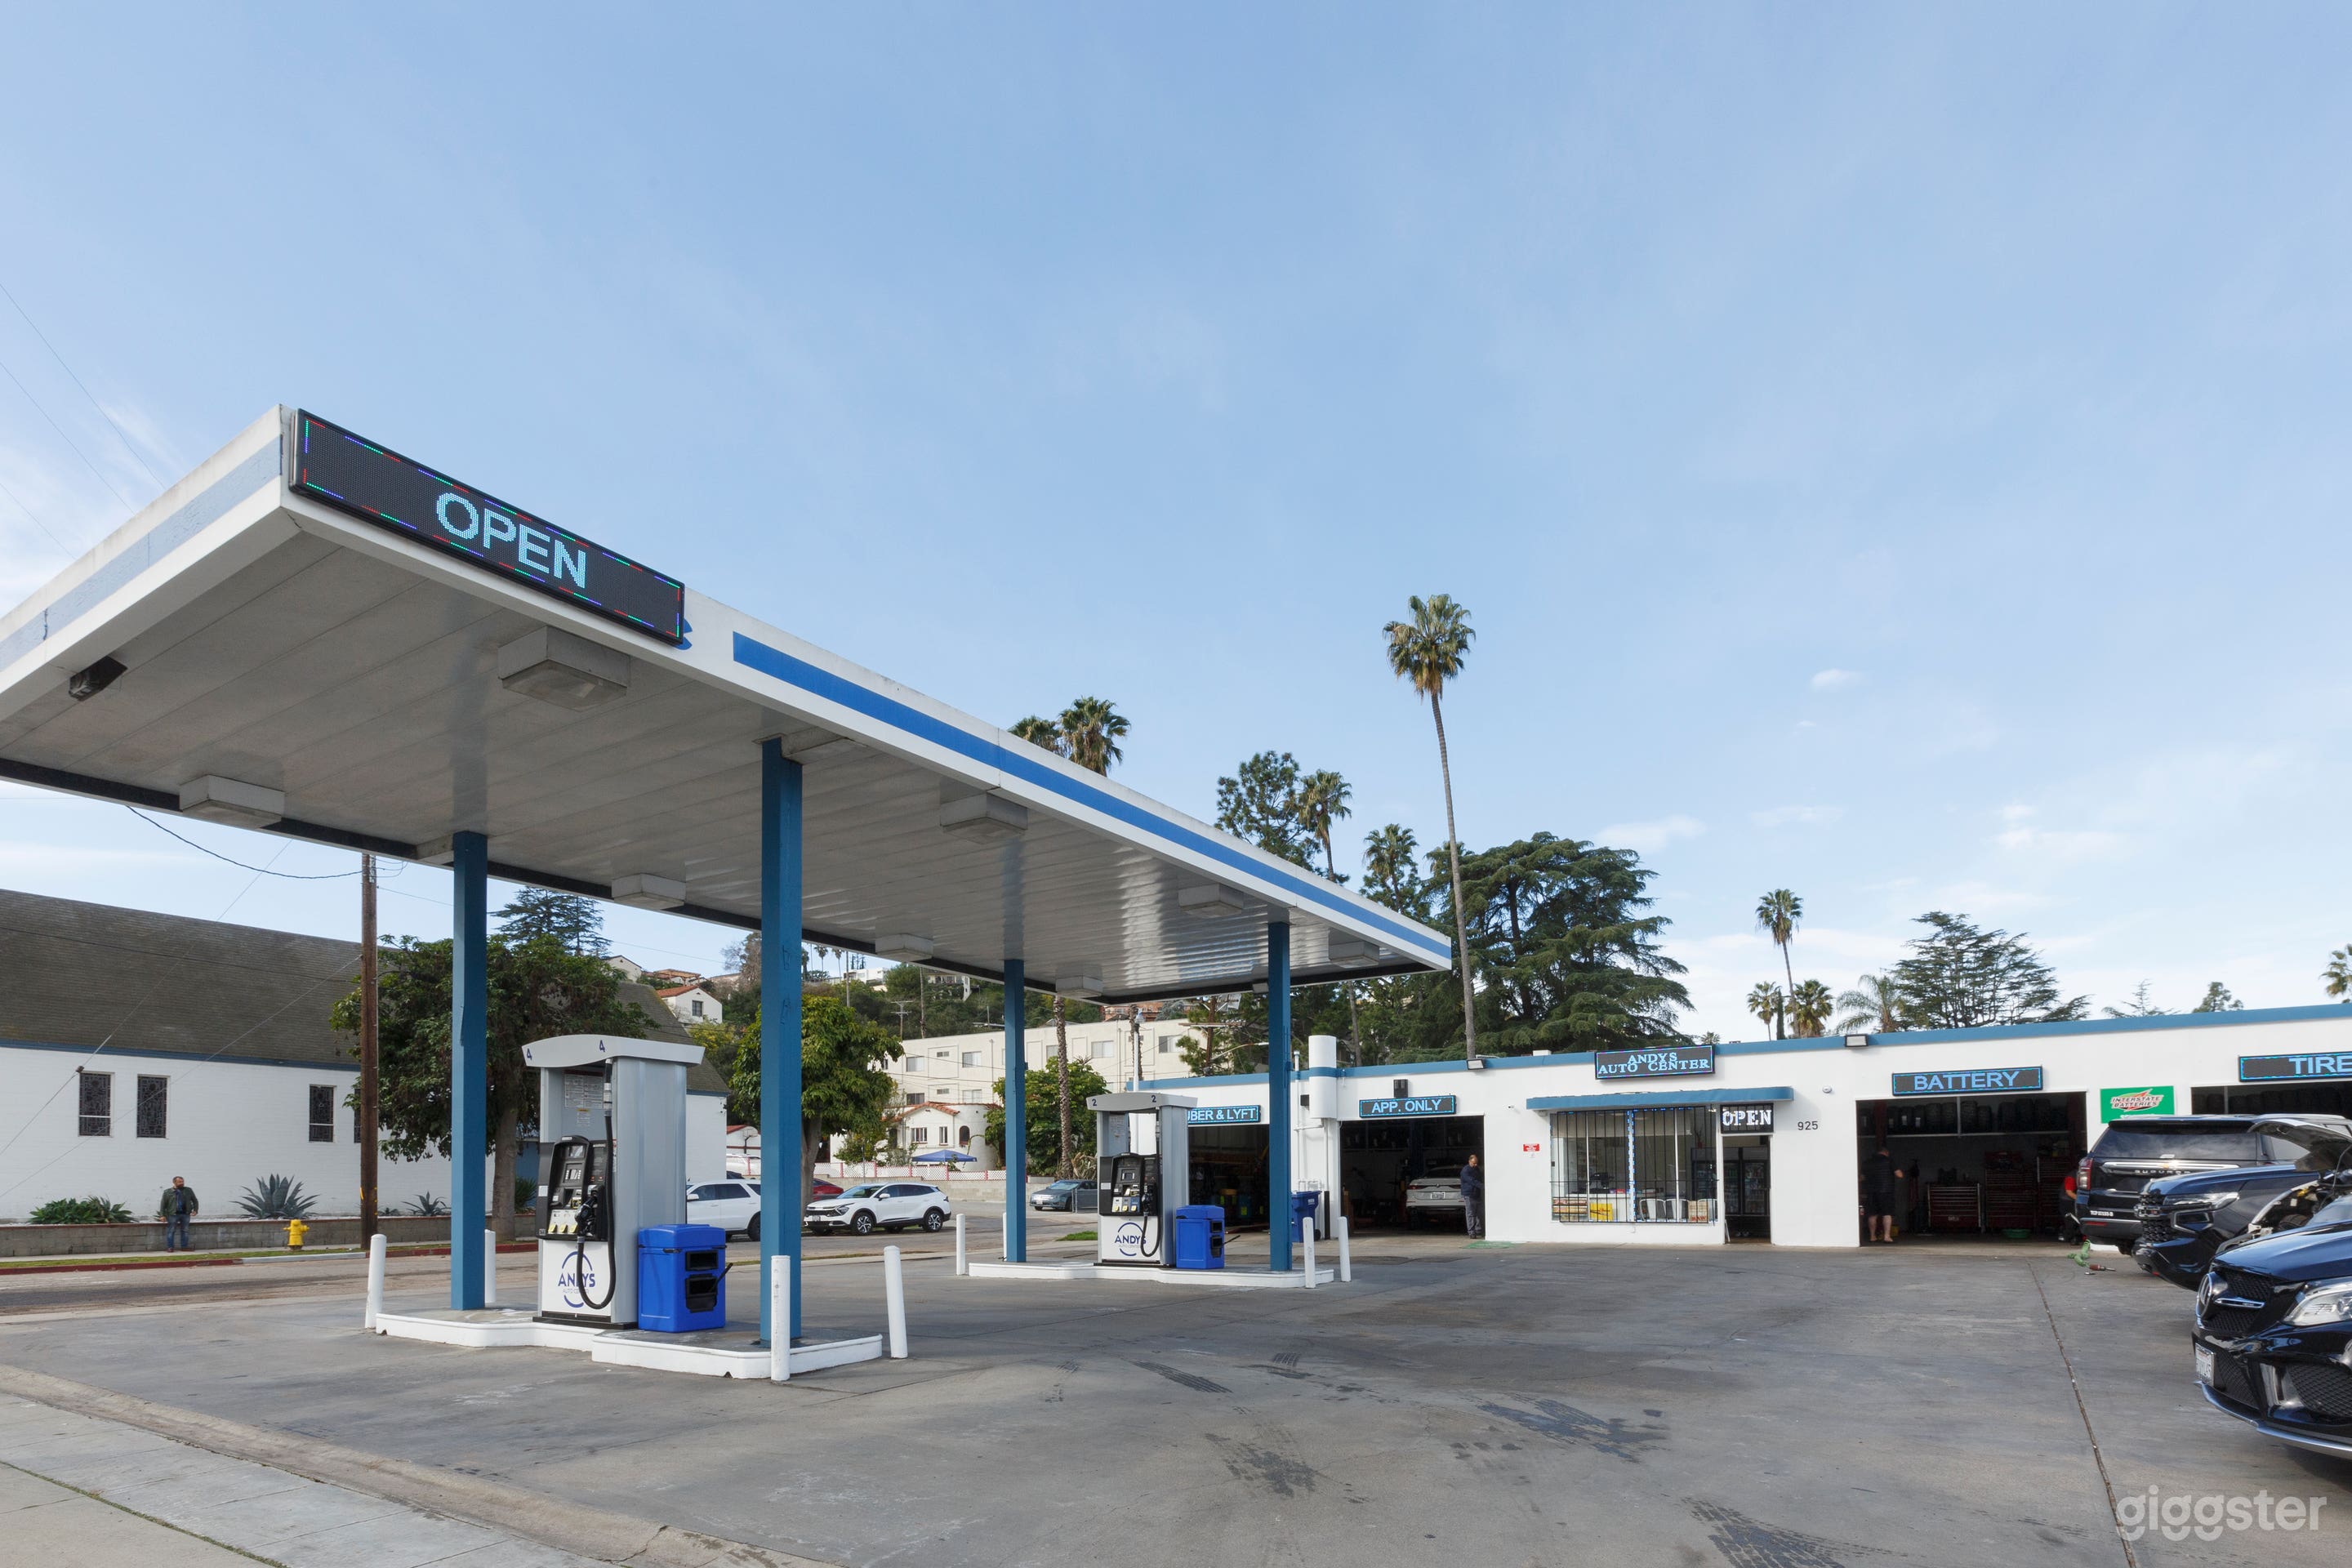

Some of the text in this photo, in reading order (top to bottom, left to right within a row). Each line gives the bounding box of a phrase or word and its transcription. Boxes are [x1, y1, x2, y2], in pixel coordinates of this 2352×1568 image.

[437, 492, 586, 589] OPEN
[599, 1040, 605, 1052] 4
[527, 1048, 532, 1060] 4
[1628, 1052, 1677, 1064] ANDYS
[1598, 1059, 1710, 1074] AUTO CENTER
[2289, 1055, 2352, 1074] TIRE
[1914, 1071, 2020, 1090] BATTERY
[1092, 1098, 1098, 1107] 2
[1152, 1095, 1157, 1103] 2
[1372, 1099, 1441, 1113] APP. ONLY
[1216, 1109, 1225, 1120] &
[1227, 1108, 1256, 1120] LYFT
[1722, 1110, 1772, 1126] OPEN
[1797, 1120, 1819, 1130] 925
[558, 1272, 595, 1288] ANYS
